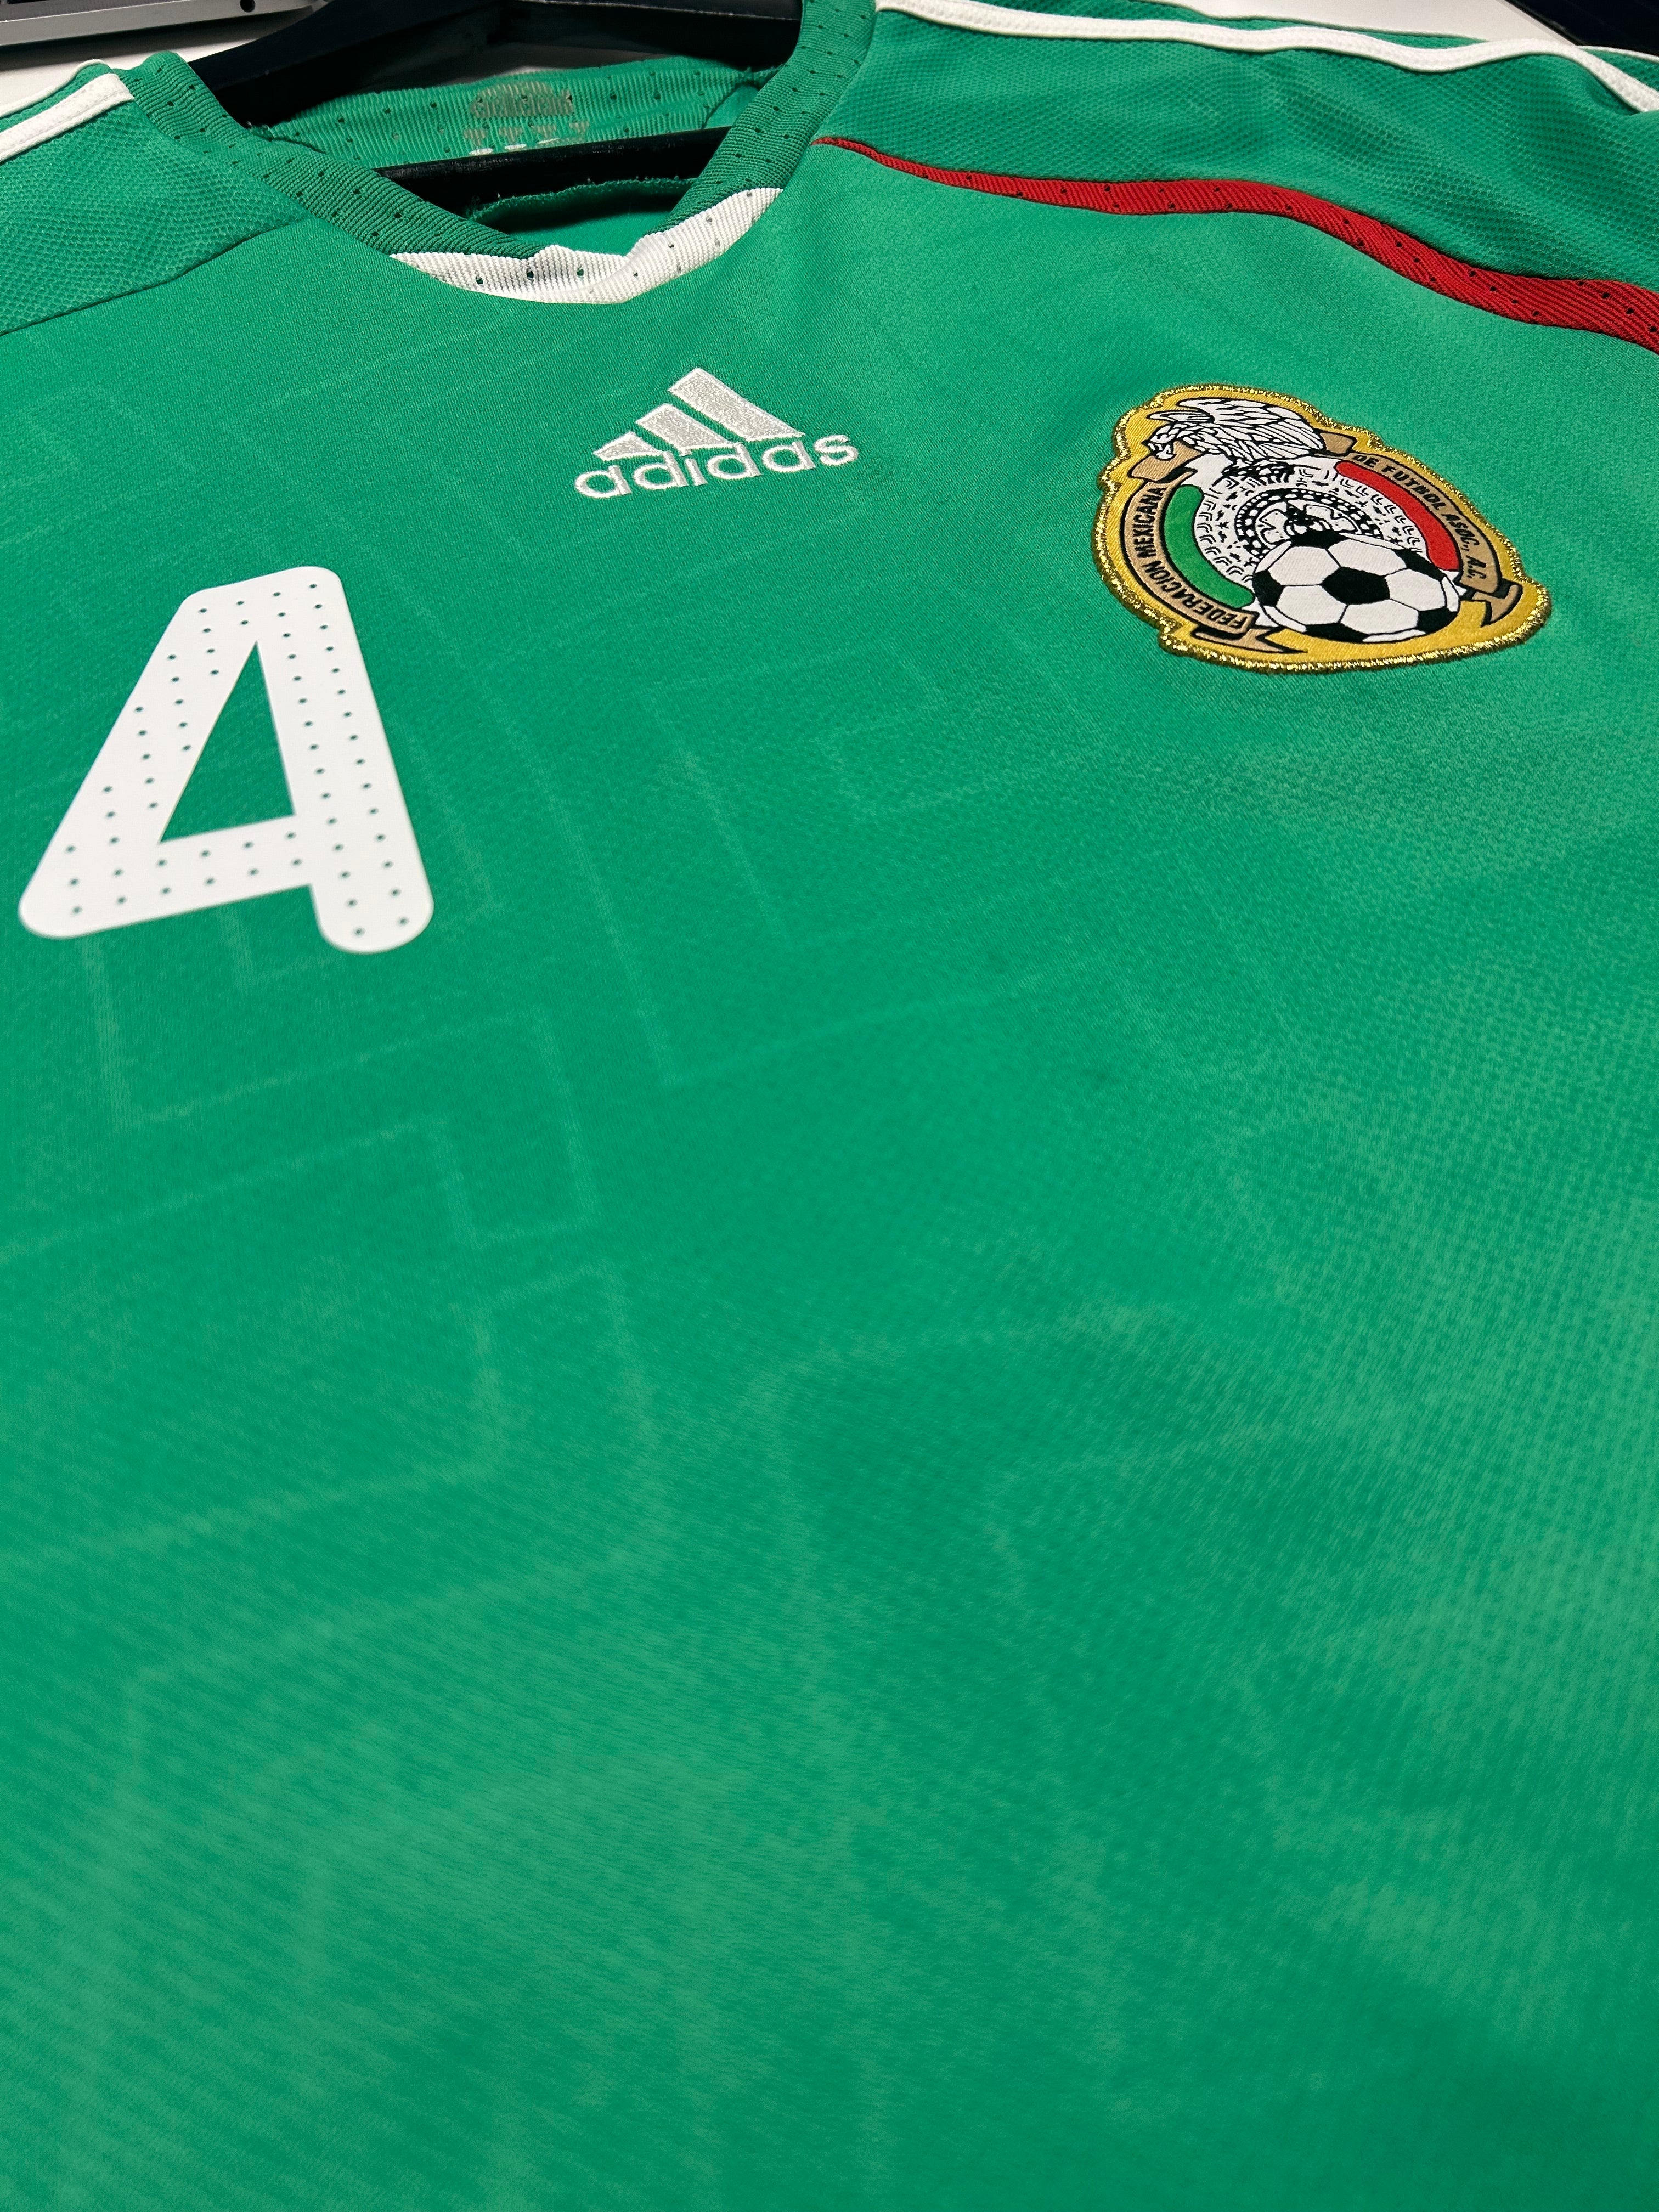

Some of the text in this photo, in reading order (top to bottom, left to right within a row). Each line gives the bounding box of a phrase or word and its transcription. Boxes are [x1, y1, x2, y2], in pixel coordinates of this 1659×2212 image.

[574, 434, 859, 498] adidas
[1352, 455, 1380, 467] DE
[1381, 466, 1447, 510] FUTBOL
[1132, 487, 1248, 629] FEDERACION MEXICANA
[18, 566, 434, 953] 4
